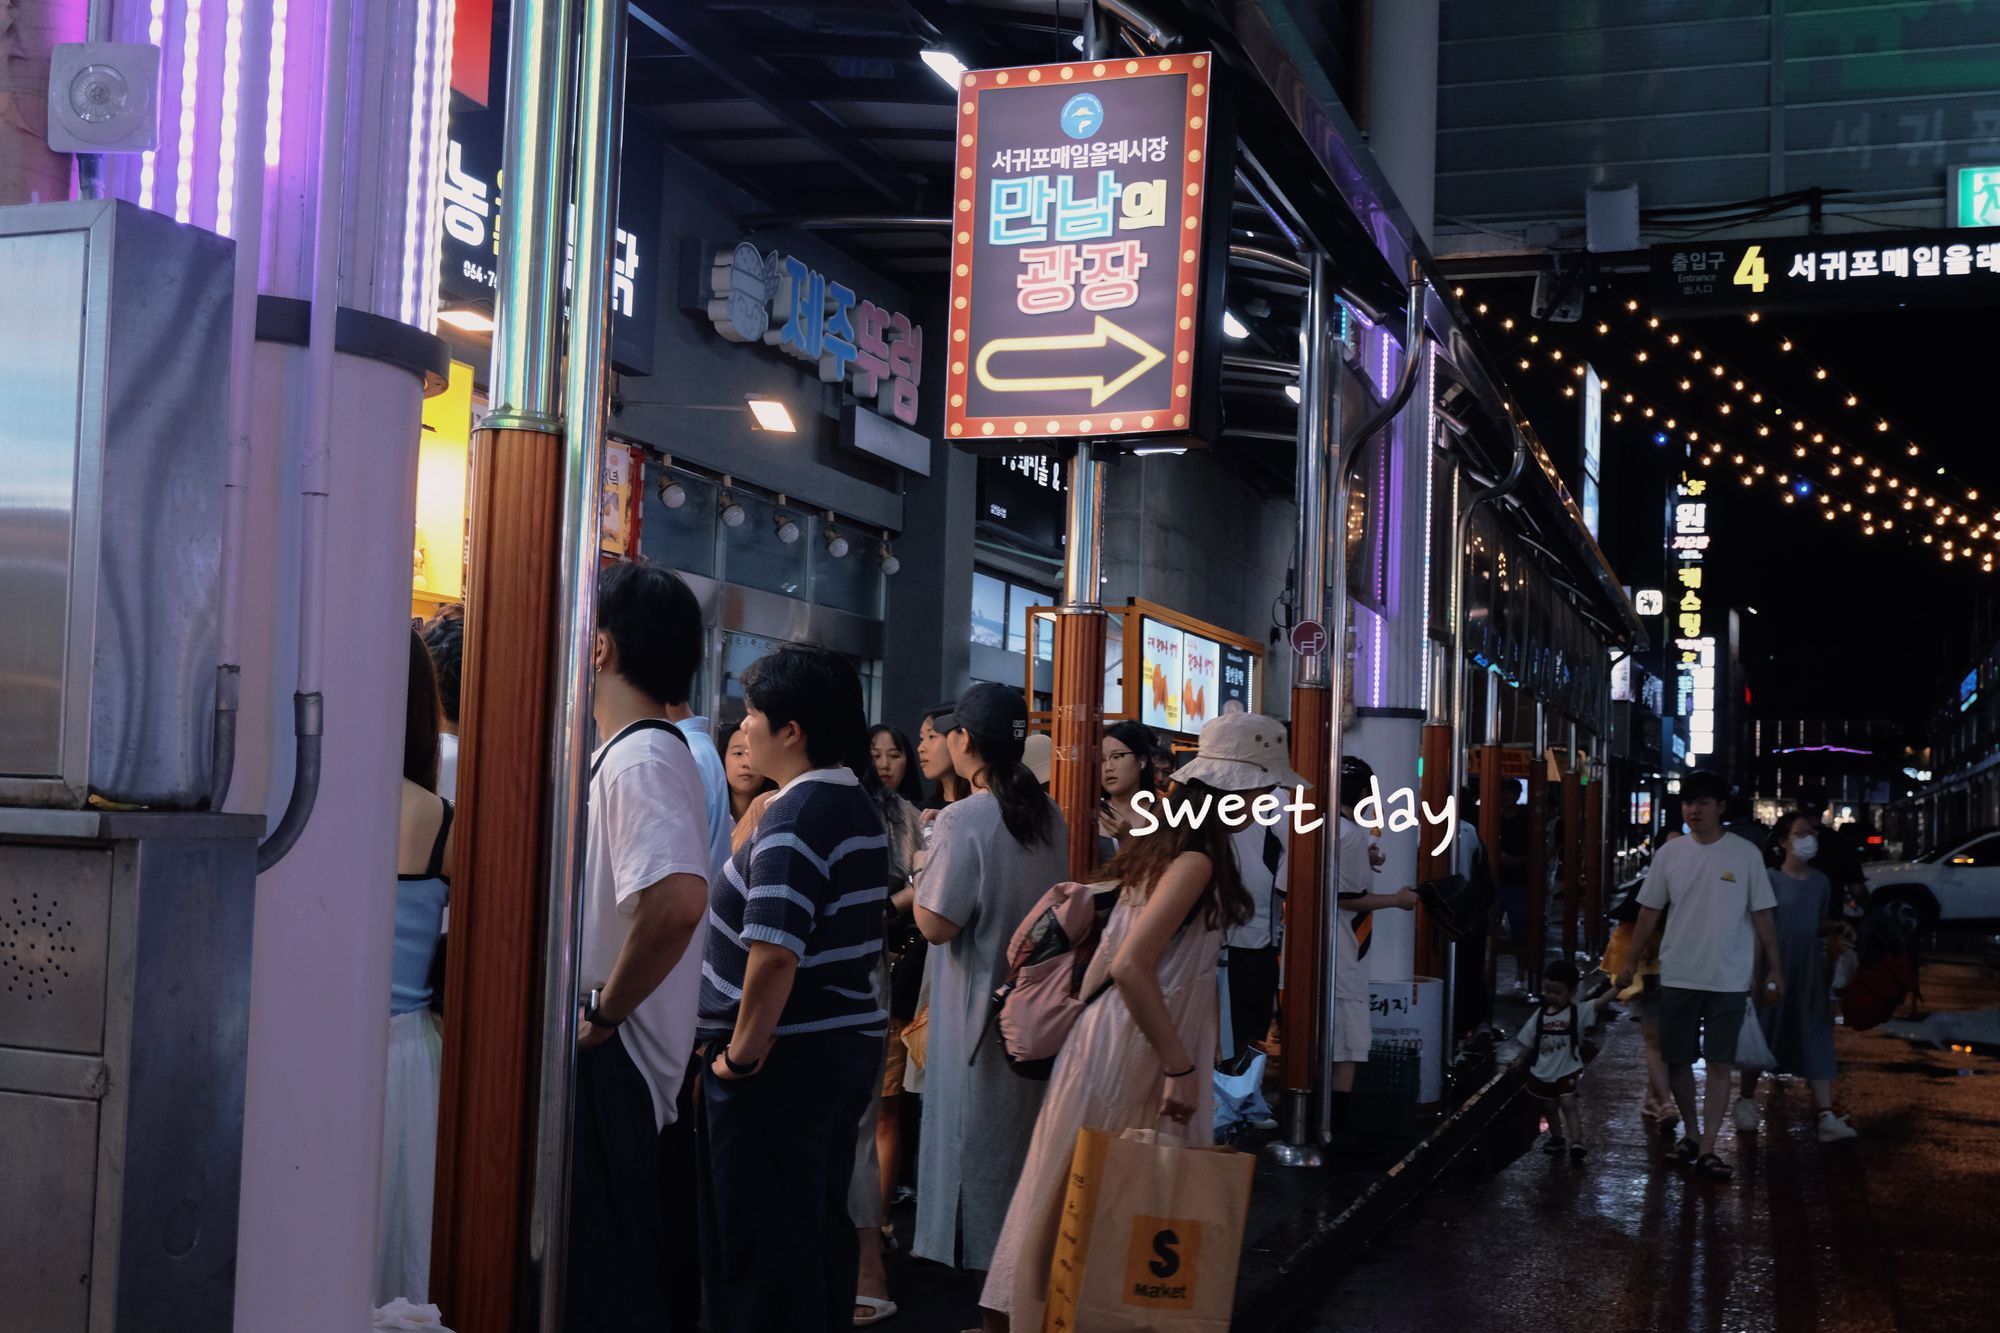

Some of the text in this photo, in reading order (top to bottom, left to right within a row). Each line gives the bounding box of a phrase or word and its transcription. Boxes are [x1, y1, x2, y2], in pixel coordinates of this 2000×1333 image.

[991, 136, 1169, 173] 서귀포매일올레시장
[989, 170, 1167, 245] 만남의
[1017, 239, 1148, 315] 광장
[1671, 251, 1726, 272] 출입구
[1677, 273, 1718, 283] Entrance
[1733, 245, 1769, 293] 4
[1683, 284, 1713, 295] 出入口
[1149, 1229, 1181, 1278] S
